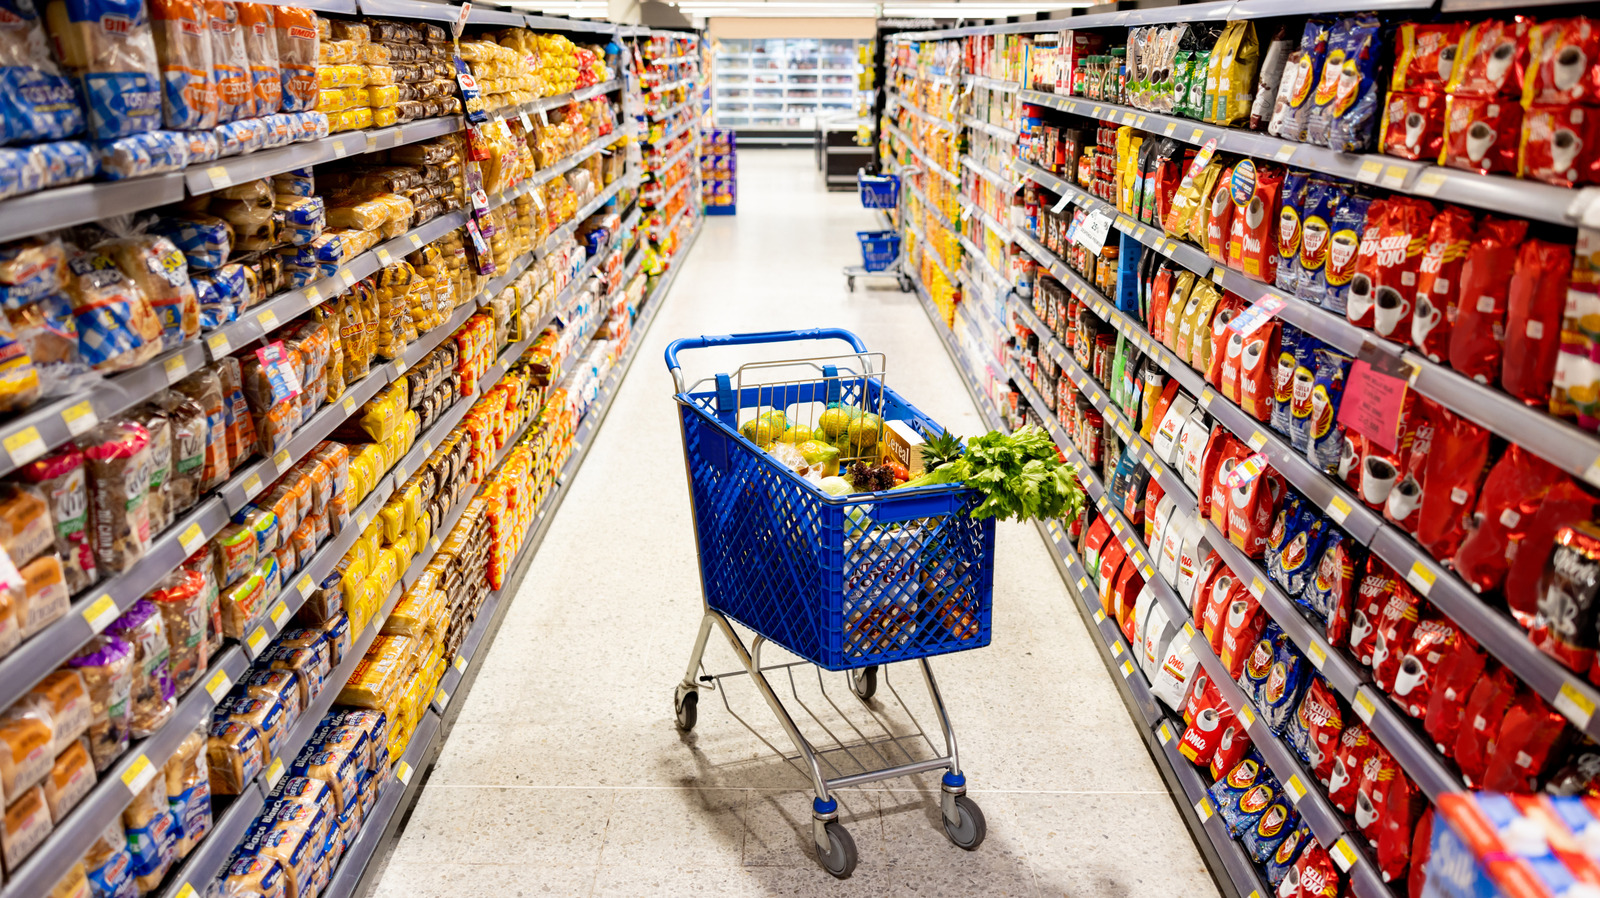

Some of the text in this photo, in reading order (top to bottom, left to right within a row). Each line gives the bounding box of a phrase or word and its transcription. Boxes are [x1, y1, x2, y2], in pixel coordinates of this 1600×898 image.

[291, 27, 316, 39] BIMBO
[1243, 234, 1260, 253] Oma
[1381, 234, 1412, 250] SELLO
[1377, 249, 1406, 268] ROJO
[885, 431, 909, 465] Cereal
[1212, 485, 1225, 508] Oma
[1229, 508, 1247, 533] Oma
[1181, 555, 1192, 568] ma
[1205, 602, 1218, 626] Oma
[1224, 626, 1237, 652] Oma
[1168, 654, 1184, 672] Oma
[1311, 701, 1331, 718] SELLO
[1184, 728, 1207, 750] Oma
